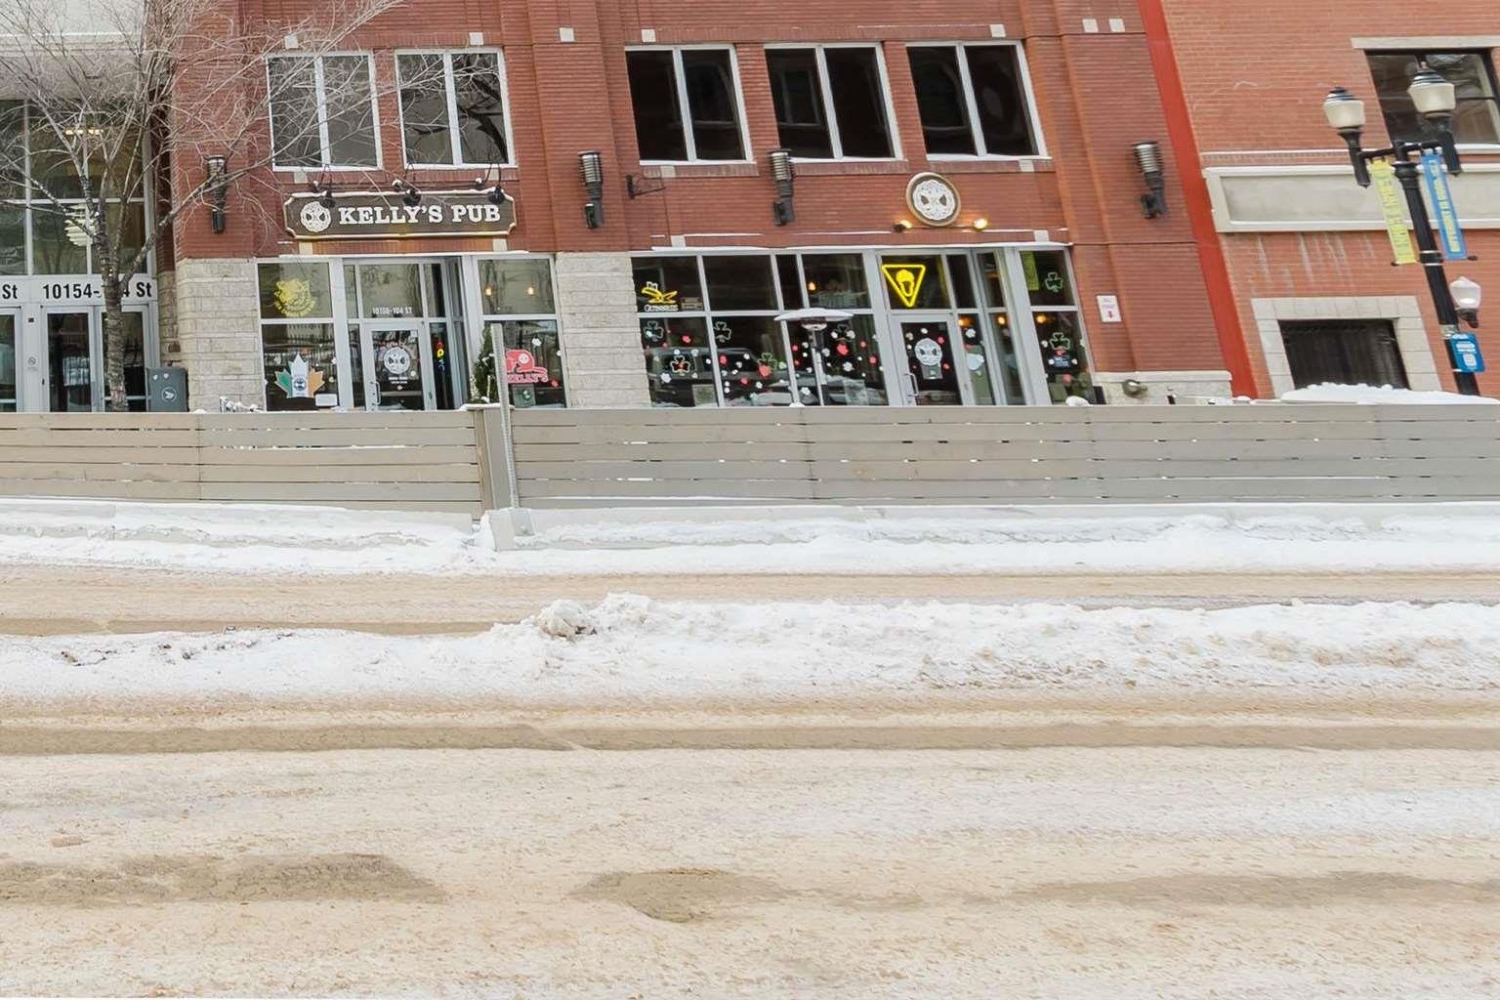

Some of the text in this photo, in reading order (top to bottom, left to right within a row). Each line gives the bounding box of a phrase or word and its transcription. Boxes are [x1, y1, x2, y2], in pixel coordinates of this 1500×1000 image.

[338, 203, 501, 225] KELLY'S PUB
[2, 284, 18, 300] St
[43, 281, 153, 299] 10154-4 St
